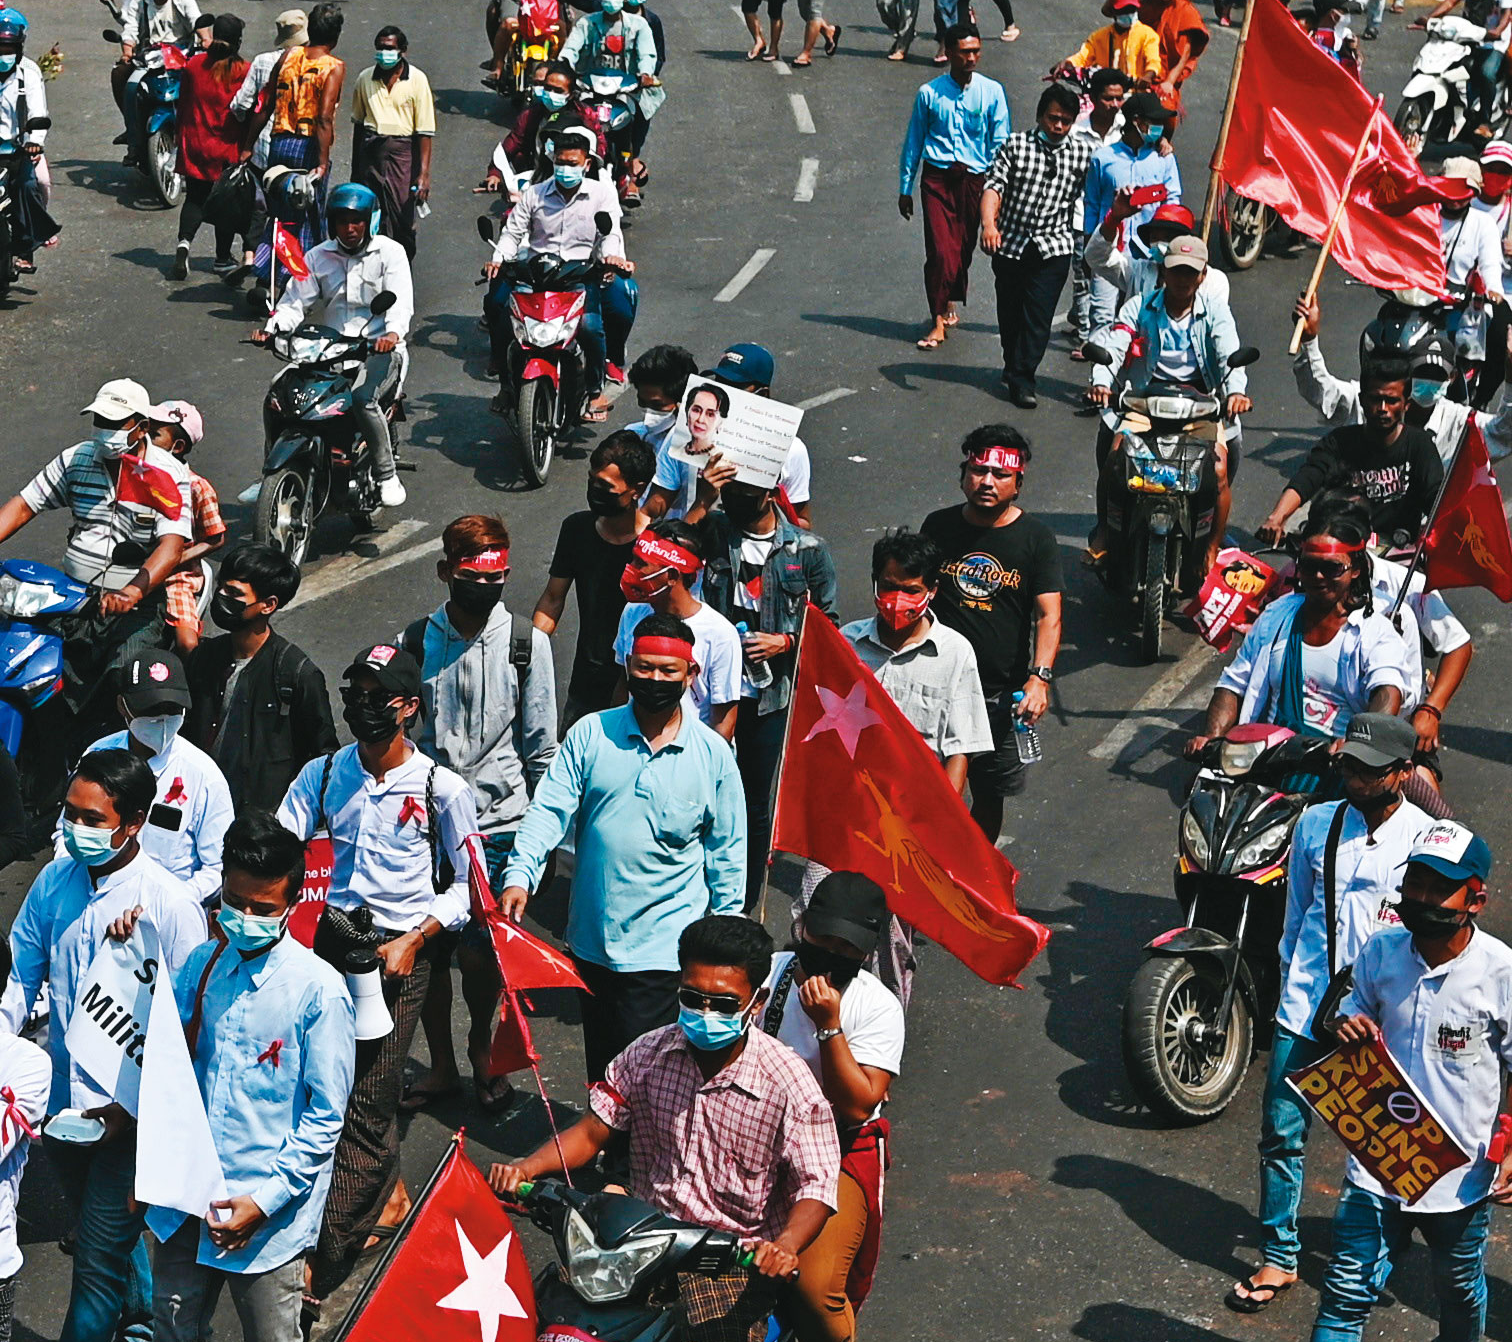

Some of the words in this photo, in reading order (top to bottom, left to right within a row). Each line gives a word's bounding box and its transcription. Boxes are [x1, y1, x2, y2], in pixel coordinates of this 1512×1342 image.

[977, 561, 1021, 589] Rock
[1299, 1069, 1424, 1201] PEOPLE
[1322, 1052, 1440, 1185] KILLING
